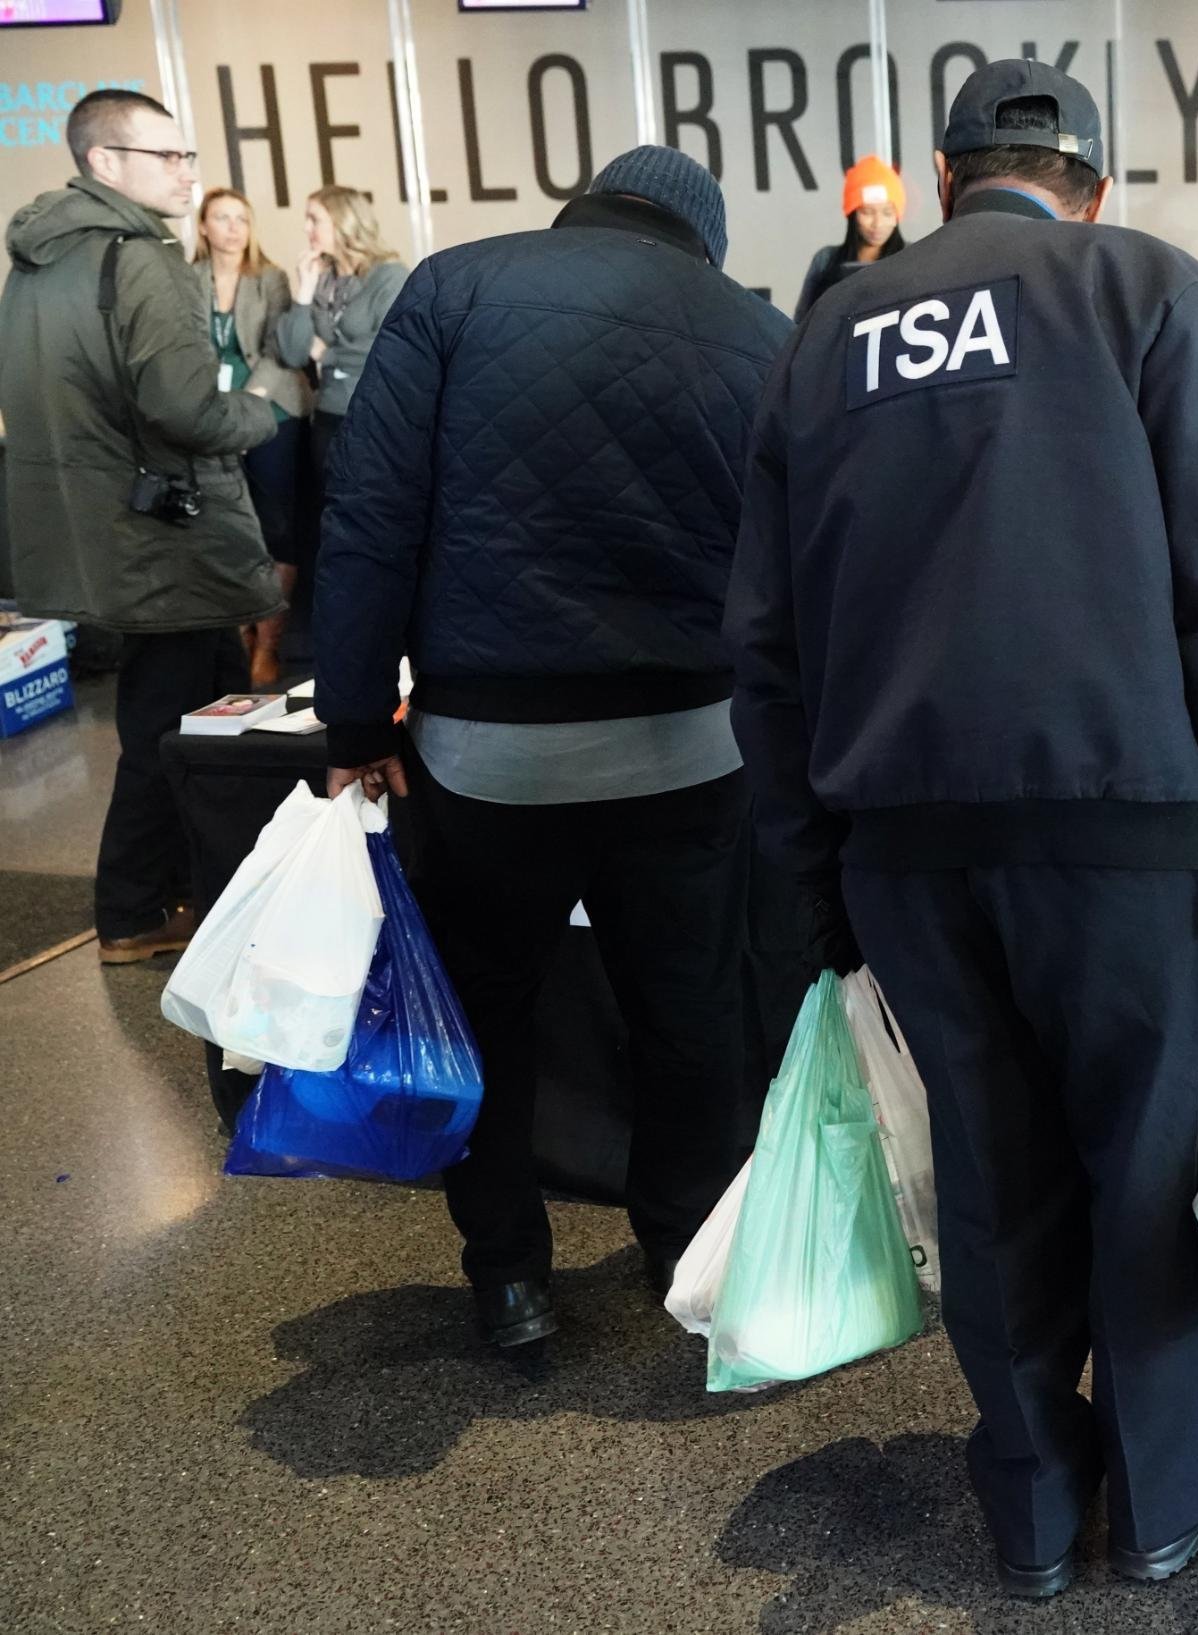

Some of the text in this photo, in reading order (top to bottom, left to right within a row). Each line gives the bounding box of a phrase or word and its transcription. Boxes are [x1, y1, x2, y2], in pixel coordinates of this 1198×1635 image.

[217, 53, 595, 208] HELLO
[853, 289, 1010, 392] TSA
[4, 667, 69, 708] BLIZZARD
